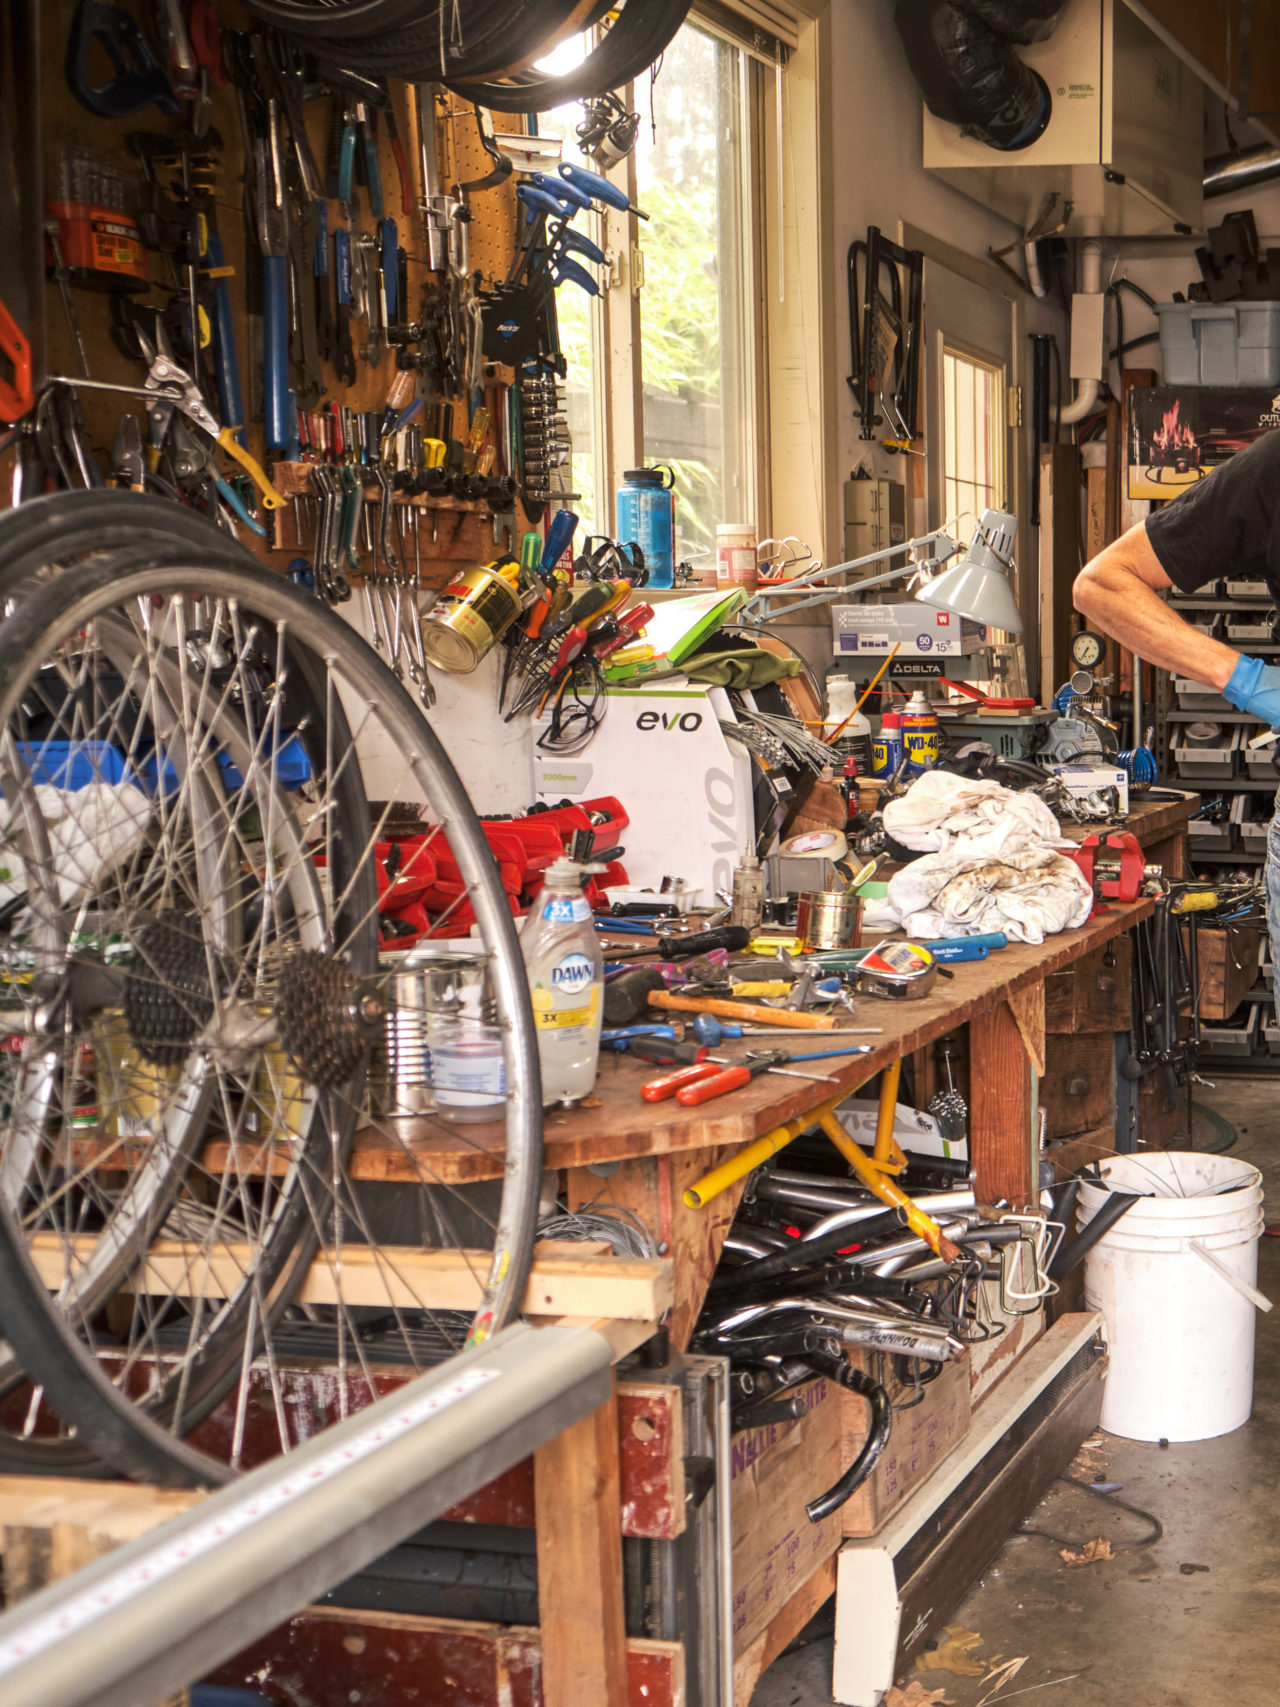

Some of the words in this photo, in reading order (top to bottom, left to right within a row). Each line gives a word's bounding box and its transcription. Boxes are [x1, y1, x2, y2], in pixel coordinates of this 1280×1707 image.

[938, 614, 948, 624] W
[919, 637, 930, 645] 50
[935, 643, 947, 652] 15
[904, 665, 941, 673] DELTA
[636, 711, 702, 732] evo
[908, 736, 938, 750] WD-40
[542, 773, 578, 781] 2000mm
[551, 964, 595, 985] DAWN
[542, 1013, 558, 1023] 3X
